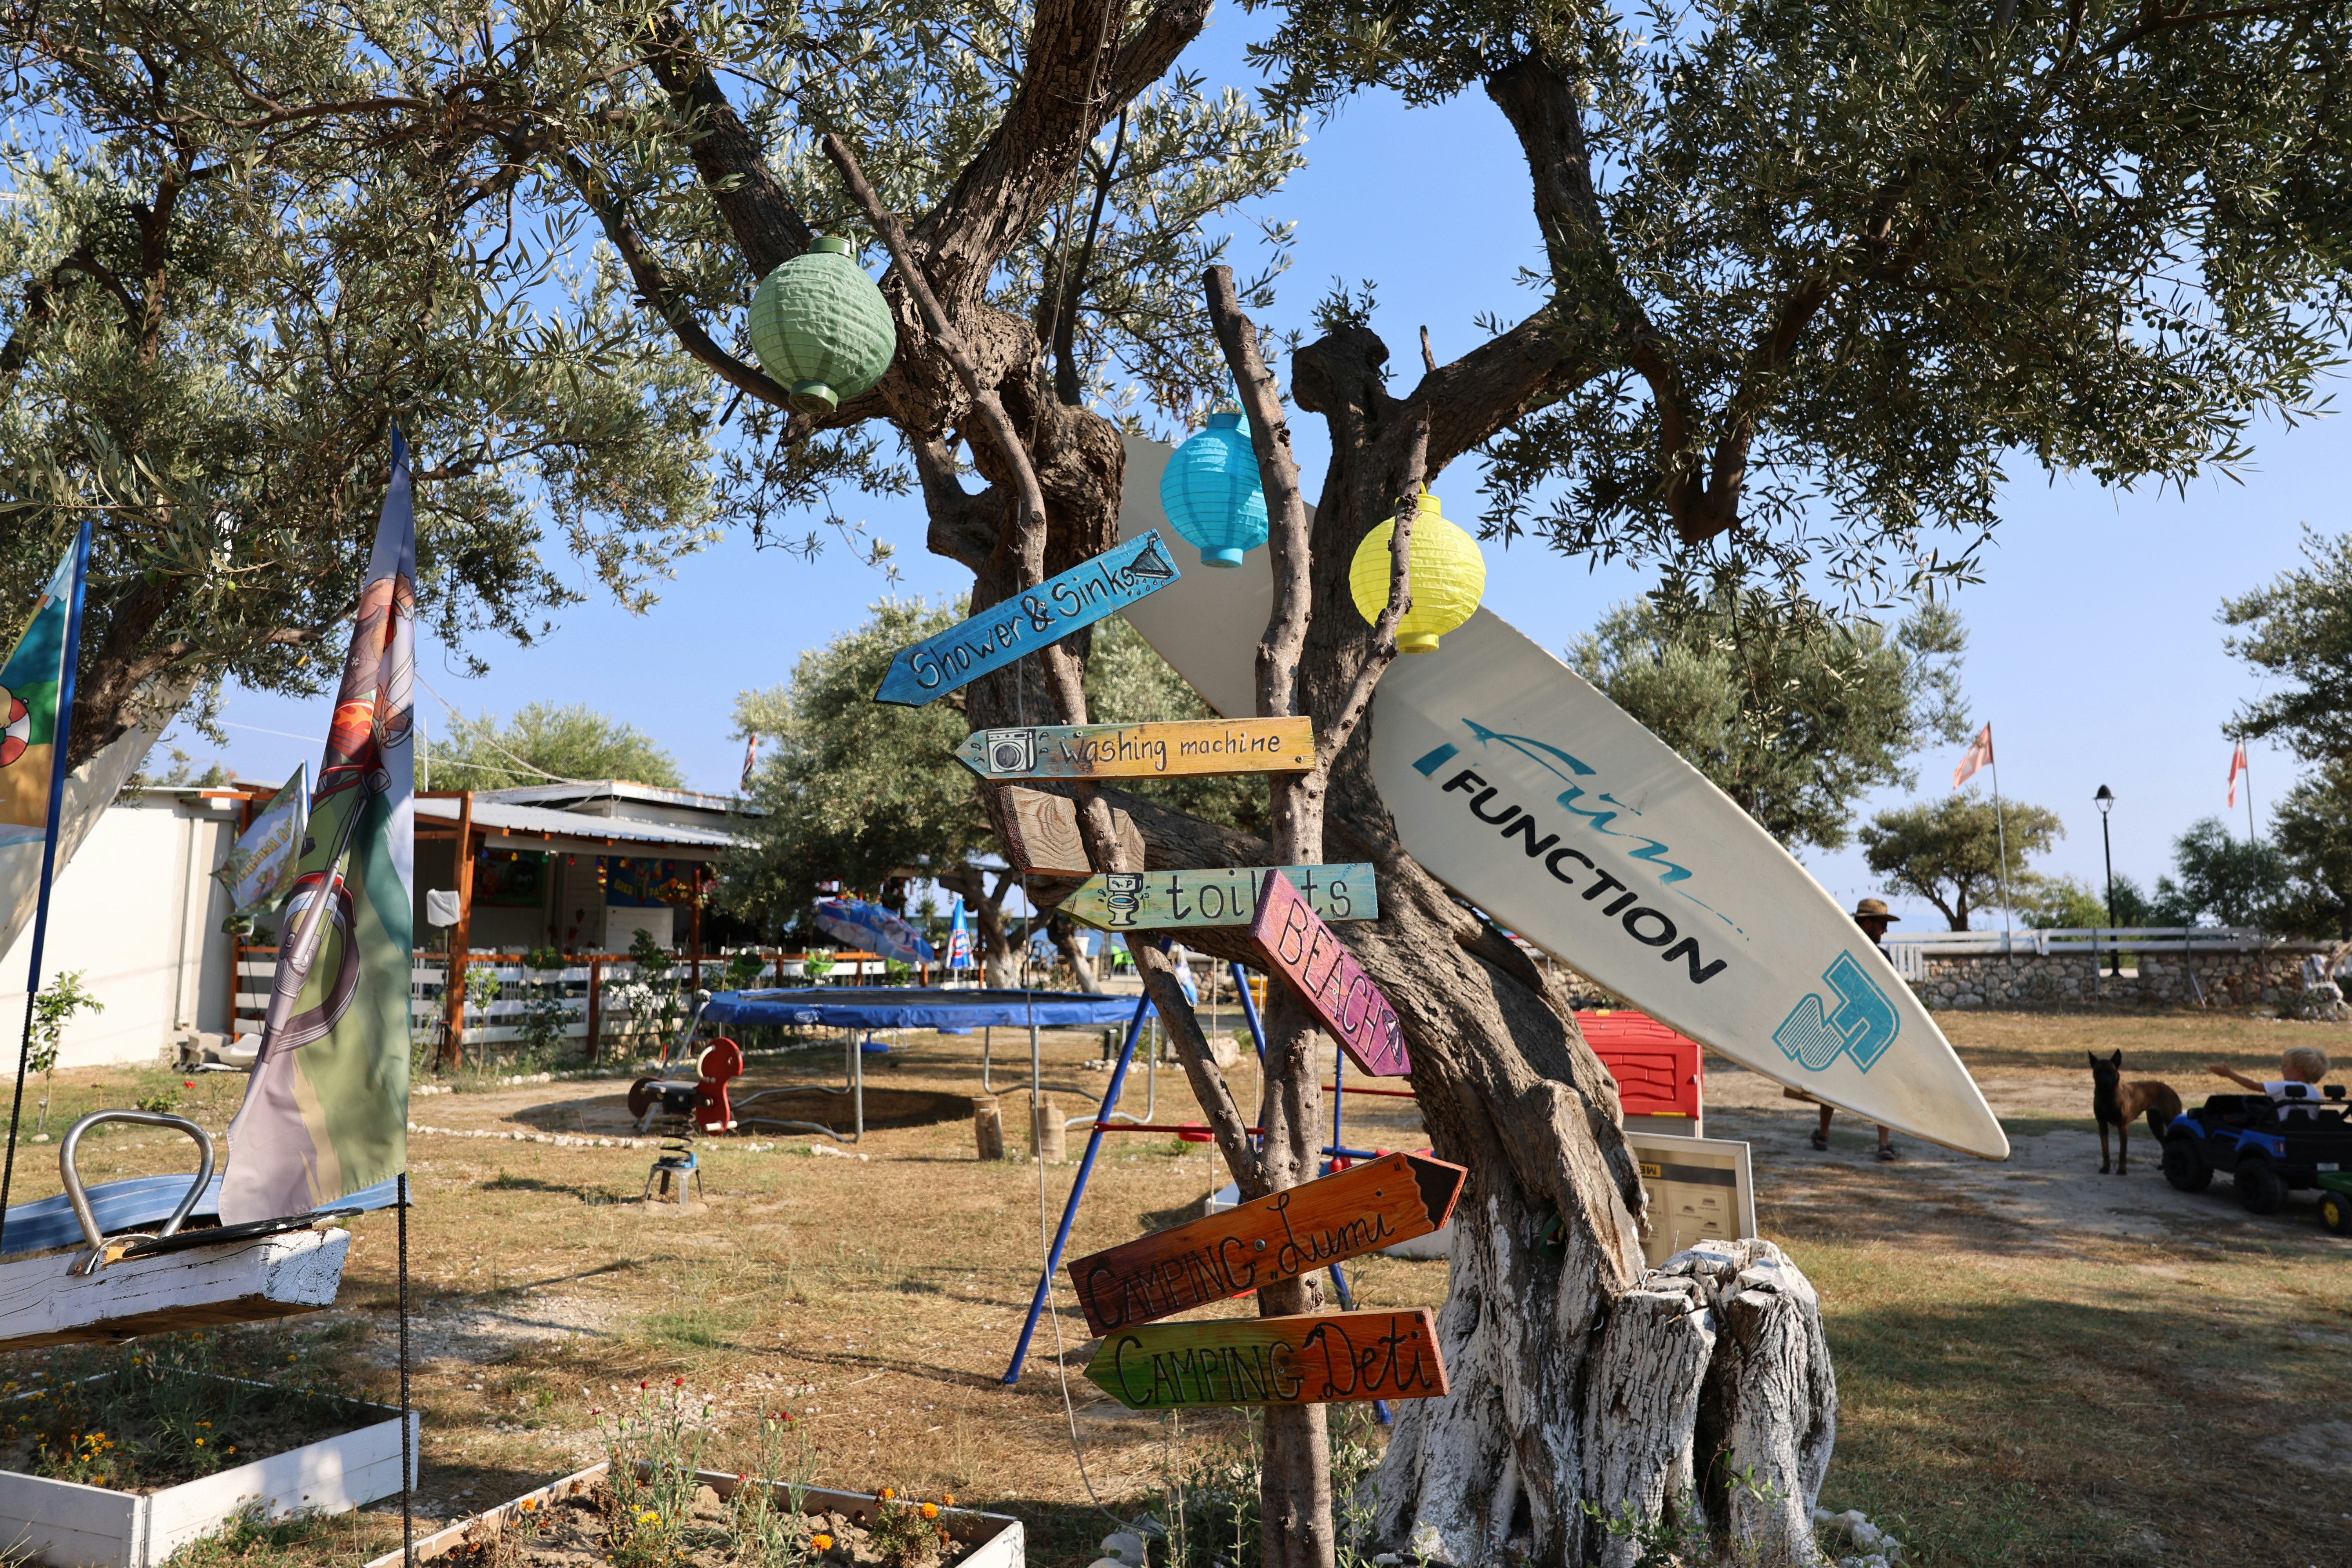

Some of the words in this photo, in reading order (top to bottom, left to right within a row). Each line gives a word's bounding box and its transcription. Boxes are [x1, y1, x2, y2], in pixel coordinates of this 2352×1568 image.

[909, 615, 1024, 689] Shower
[1021, 595, 1055, 632] &
[1051, 561, 1135, 617] Sinks
[1181, 730, 1281, 757] machine
[614, 878, 633, 896] BIER
[1166, 869, 1351, 920] toilts
[1441, 769, 1728, 984] FUNCTION
[1277, 898, 1384, 1057] BEACH
[1086, 1236, 1256, 1330] CAMPING
[1115, 1336, 1305, 1406] CAMPING
